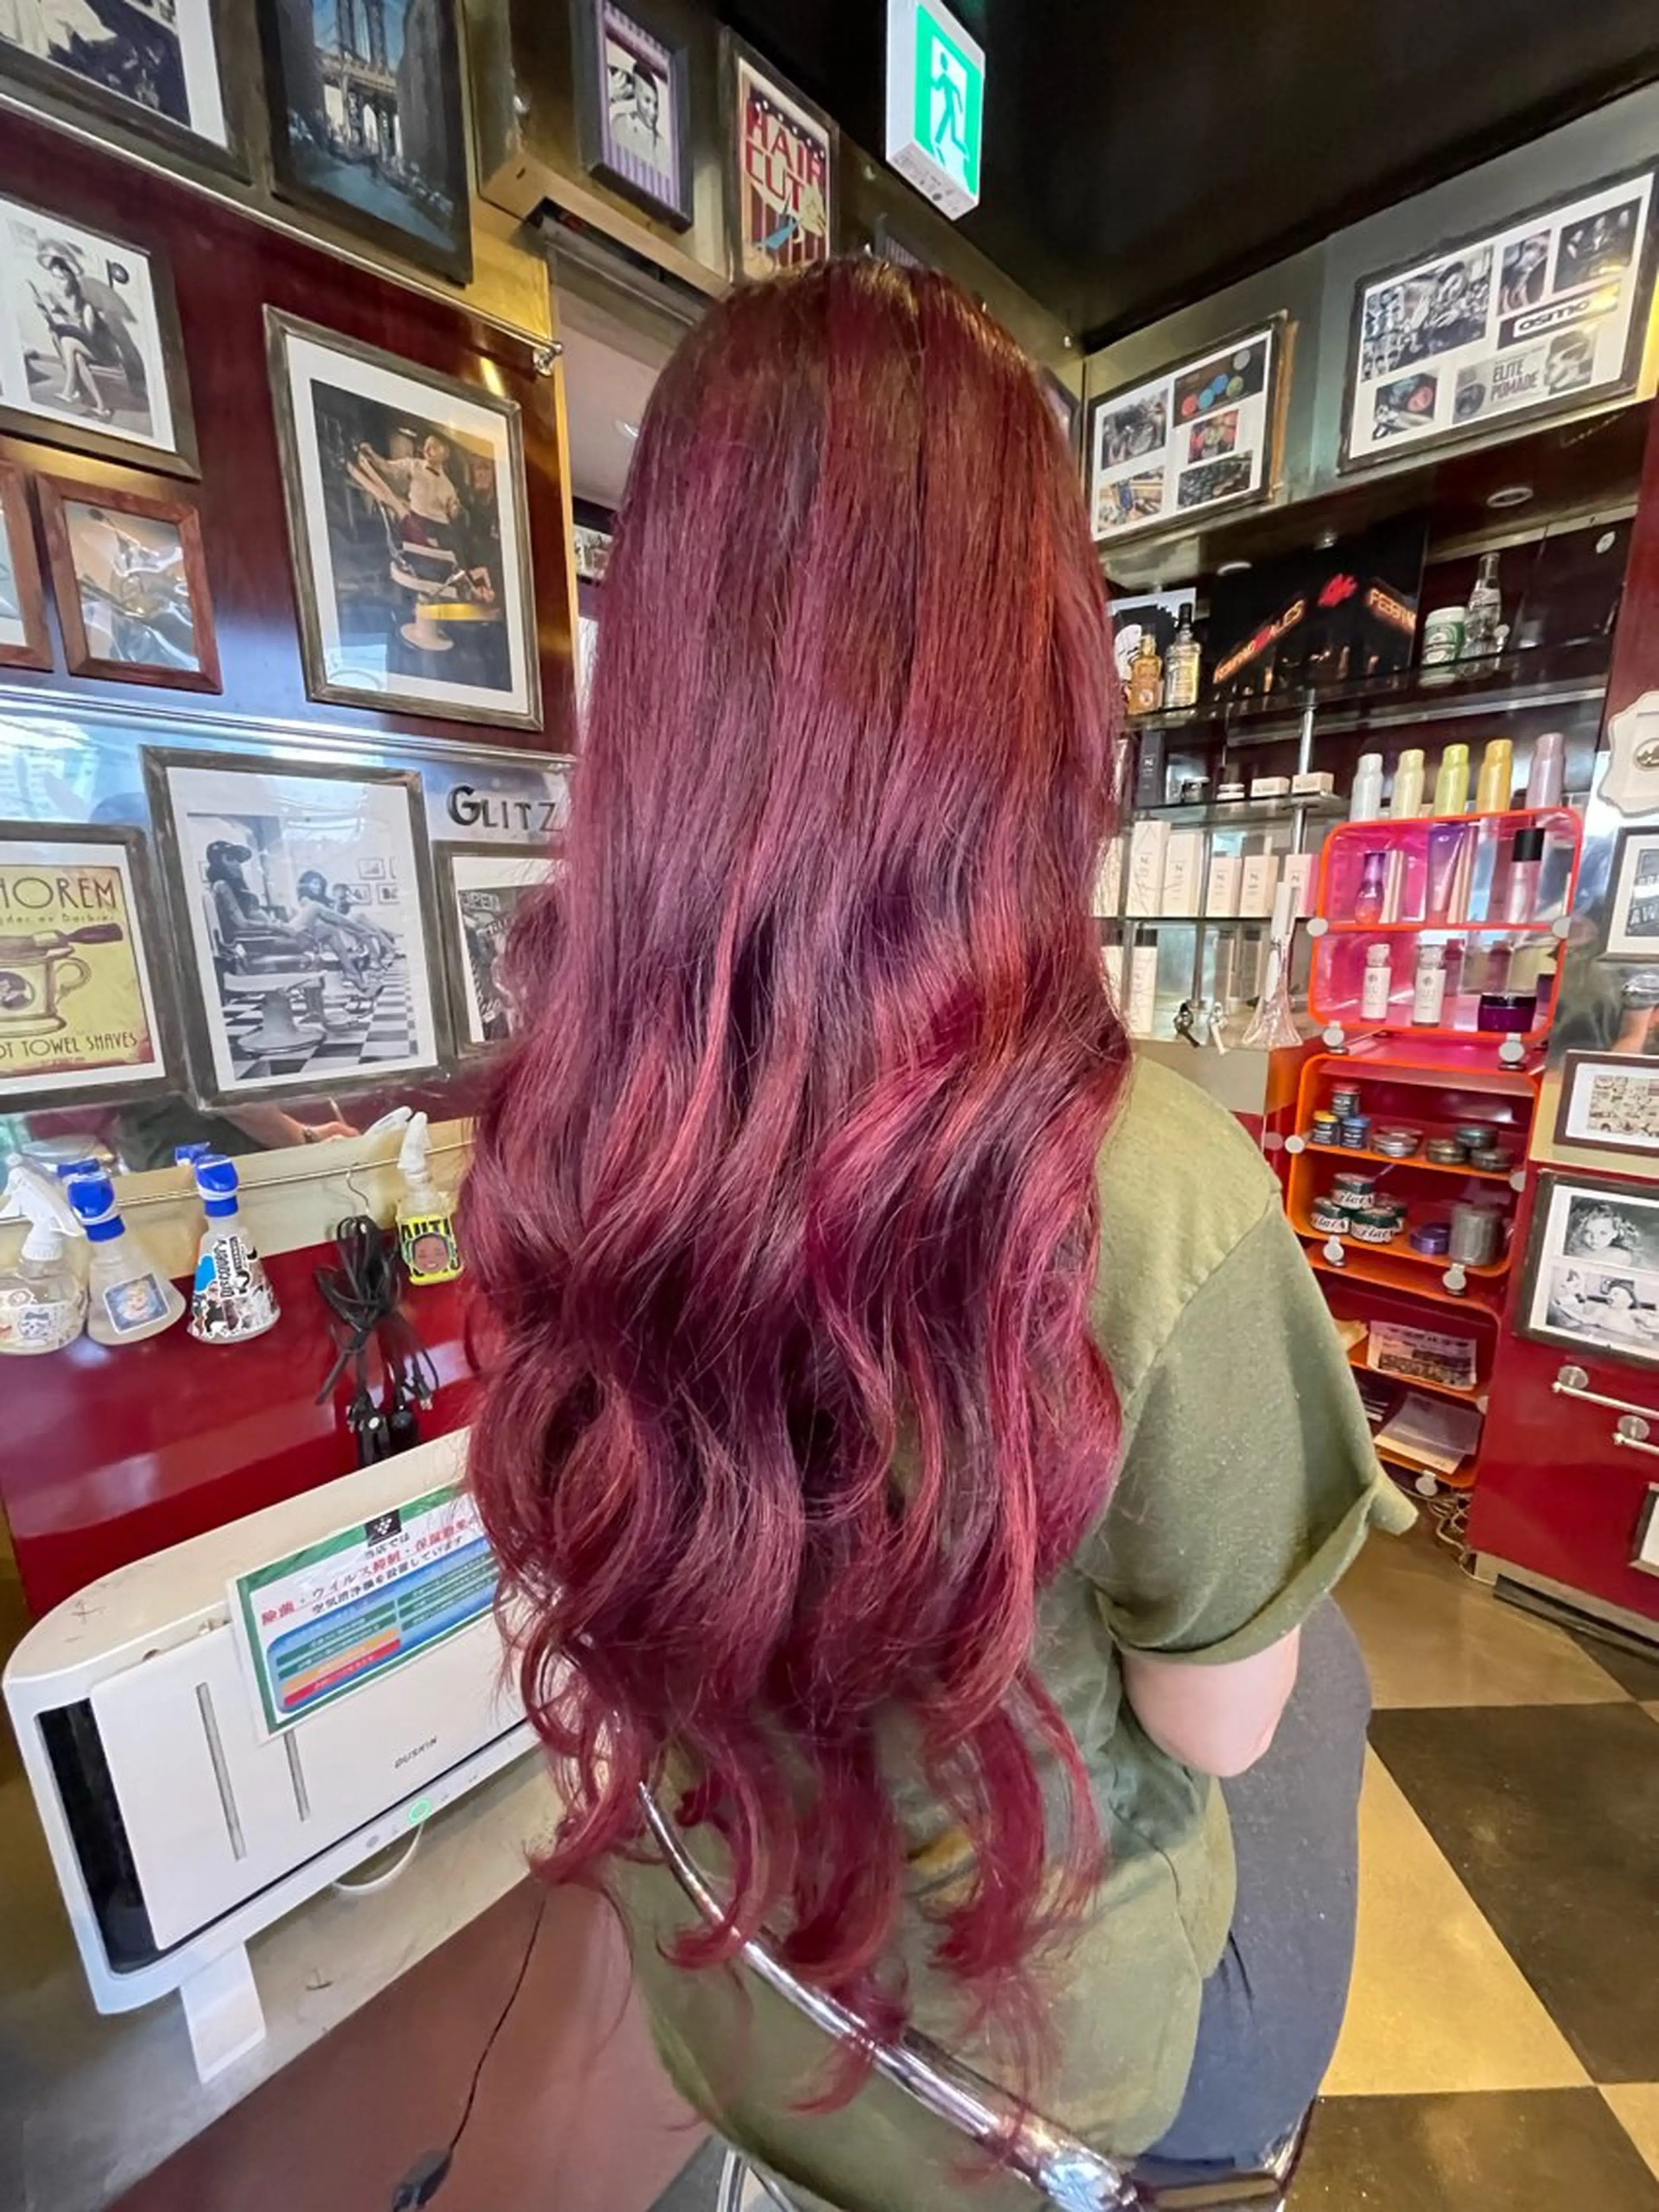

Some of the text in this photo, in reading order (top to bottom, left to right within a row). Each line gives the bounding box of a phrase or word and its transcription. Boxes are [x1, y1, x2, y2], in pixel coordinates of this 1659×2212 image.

[746, 104, 826, 190] HAIR
[746, 138, 805, 213] CUT
[1491, 369, 1539, 402] POMADE
[1494, 359, 1524, 383] ELITE
[446, 785, 562, 833] GLITZ
[22, 1036, 81, 1057] TOWEL
[86, 1031, 137, 1051] SHAVES
